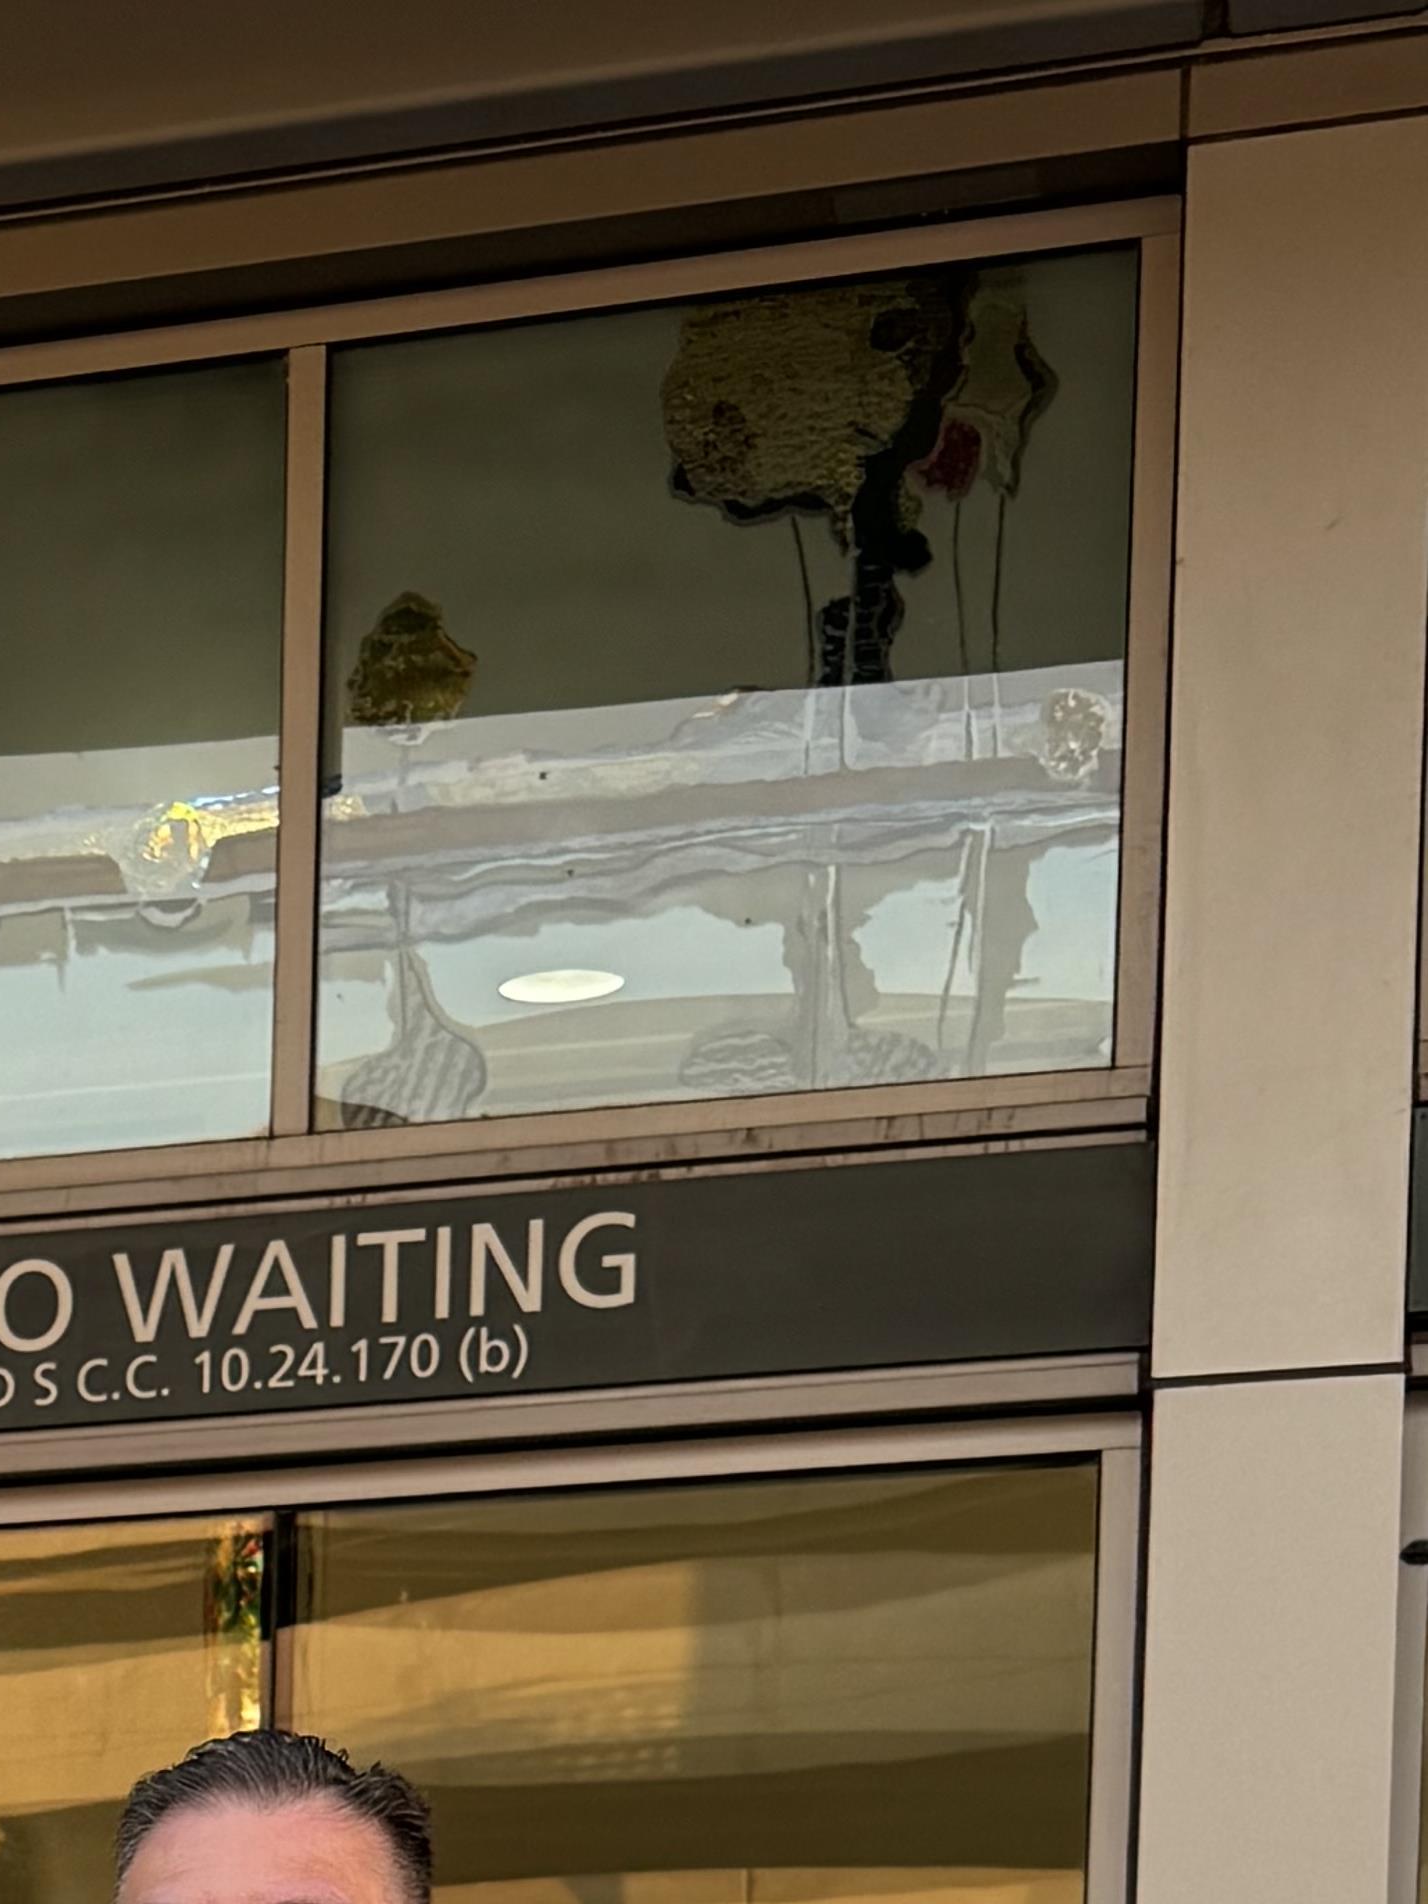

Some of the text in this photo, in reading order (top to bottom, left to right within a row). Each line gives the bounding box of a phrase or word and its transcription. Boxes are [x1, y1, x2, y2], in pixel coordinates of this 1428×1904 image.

[111, 1211, 637, 1344] WAITING
[32, 1362, 59, 1407] S
[76, 1353, 171, 1403] C.C.
[193, 1333, 441, 1395] 10.24.170
[458, 1322, 529, 1384] (b)
